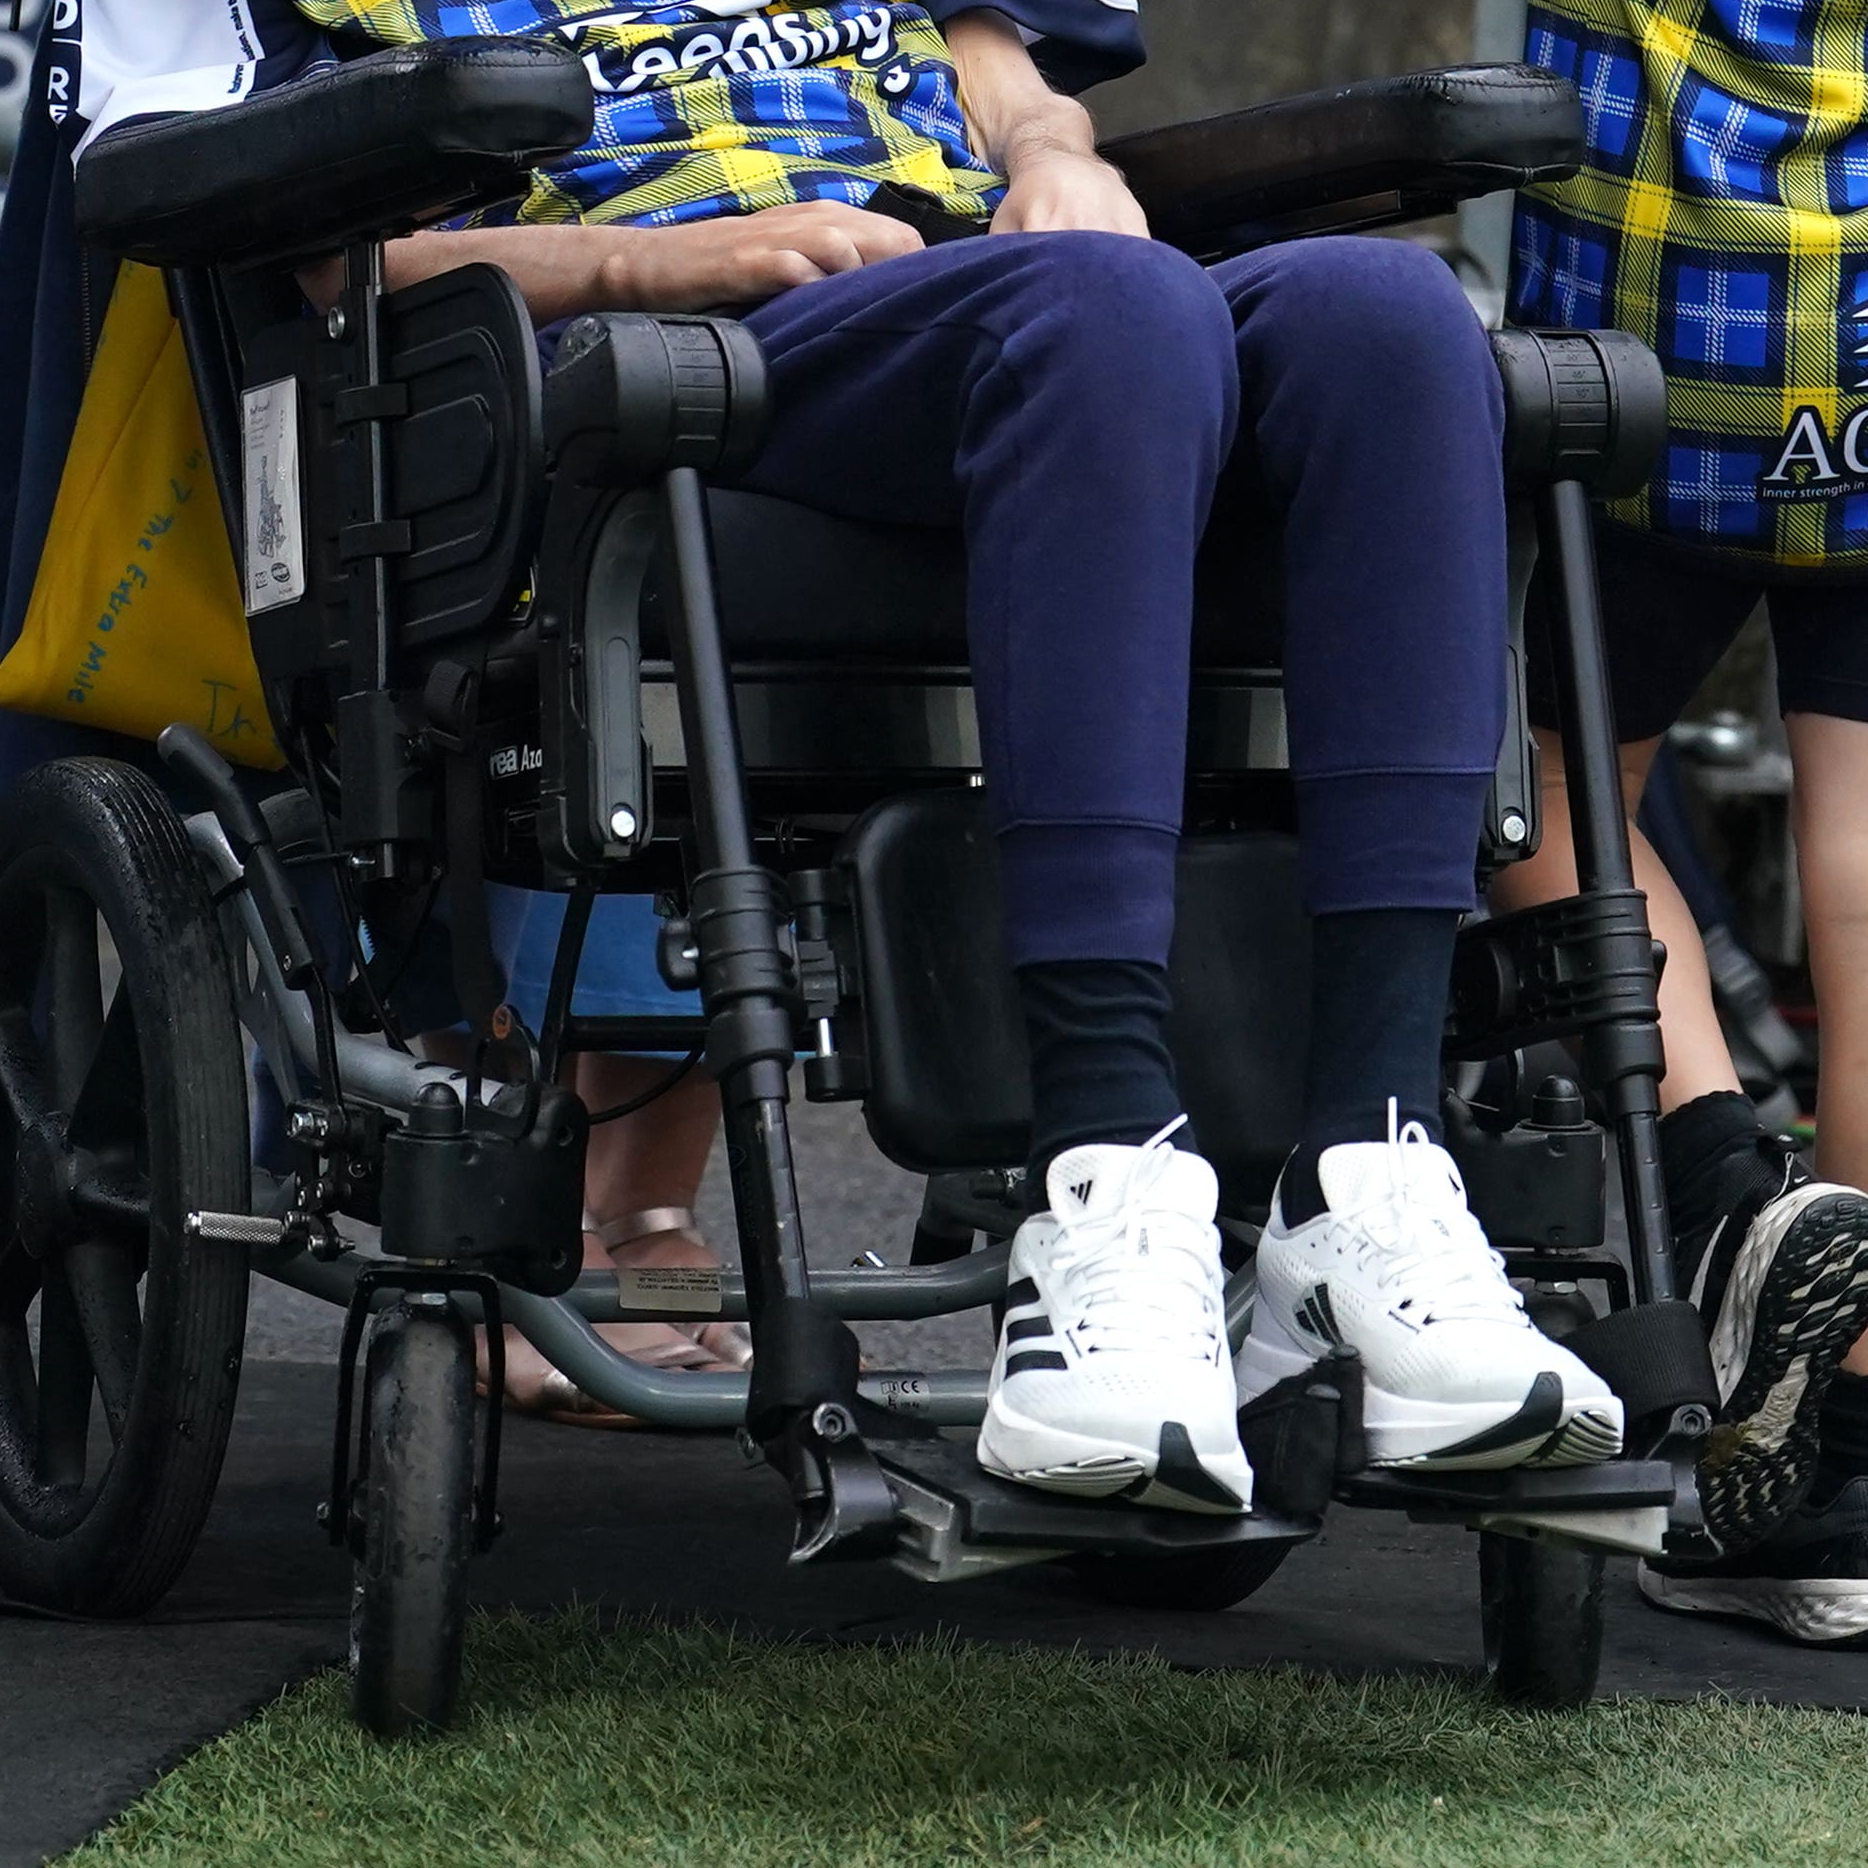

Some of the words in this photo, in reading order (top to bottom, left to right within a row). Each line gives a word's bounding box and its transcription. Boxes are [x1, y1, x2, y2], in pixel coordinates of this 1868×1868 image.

[1762, 487, 1796, 499] inner
[1799, 483, 1851, 498] strength
[1853, 480, 1865, 490] in
[98, 563, 148, 632] Extra
[68, 640, 107, 704] Mile
